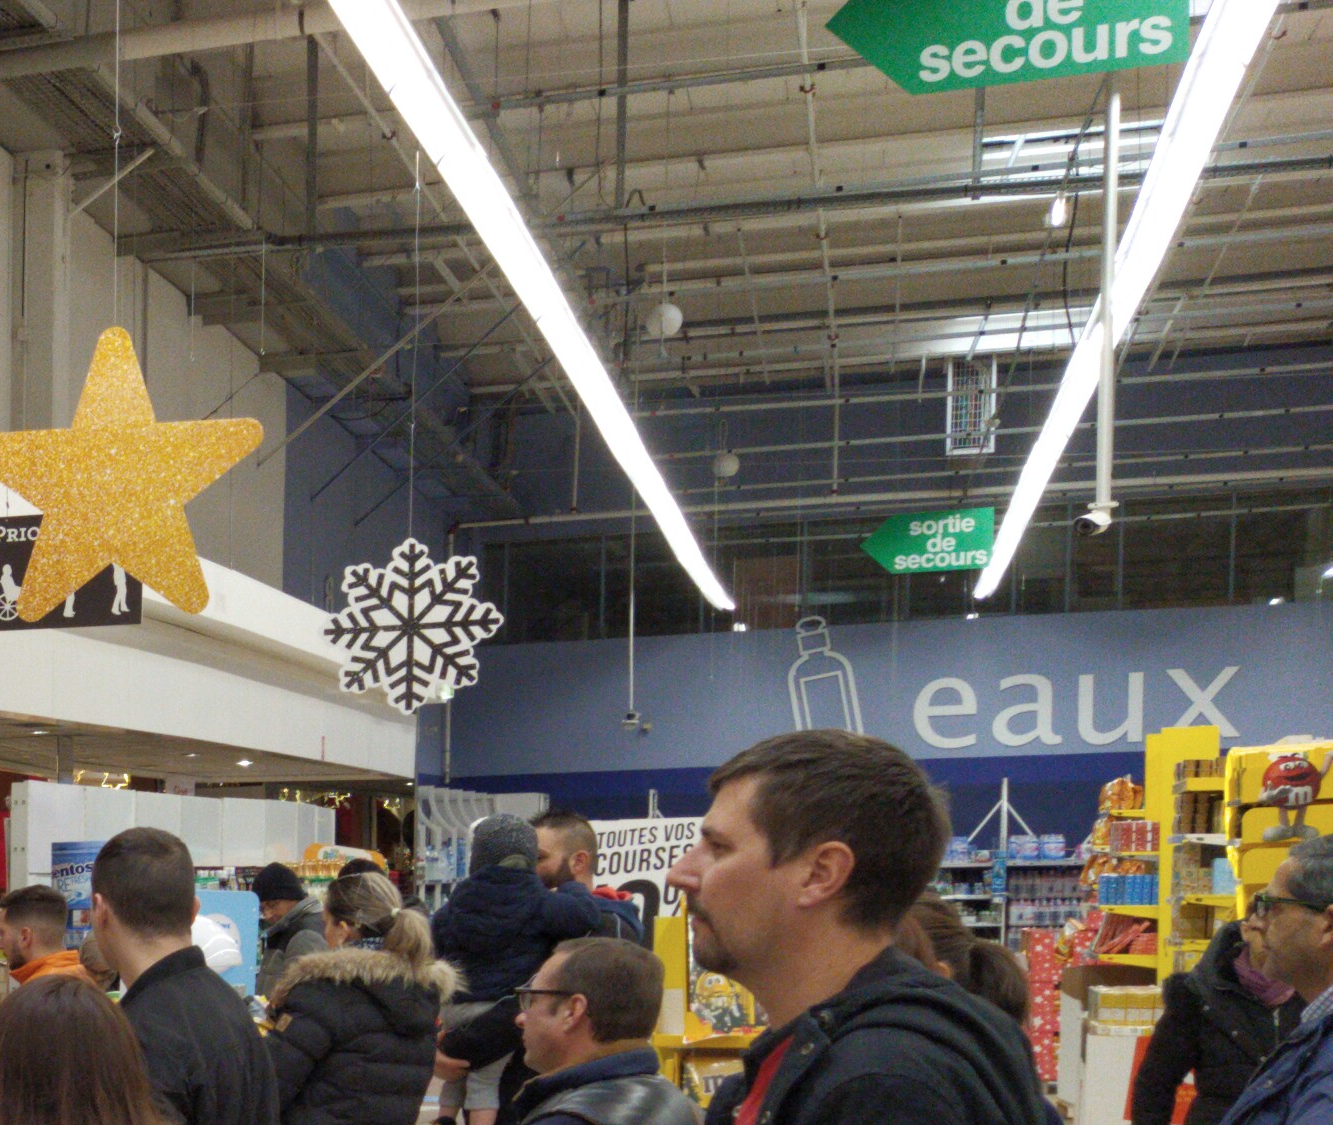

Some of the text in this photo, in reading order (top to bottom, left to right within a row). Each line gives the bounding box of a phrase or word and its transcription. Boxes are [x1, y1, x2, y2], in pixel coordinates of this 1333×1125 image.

[919, 14, 1174, 83] secours
[909, 513, 975, 538] sortie
[926, 533, 956, 553] de
[893, 547, 988, 572] secours
[912, 665, 1242, 749] eaux
[597, 822, 695, 849] TOUTES VOS
